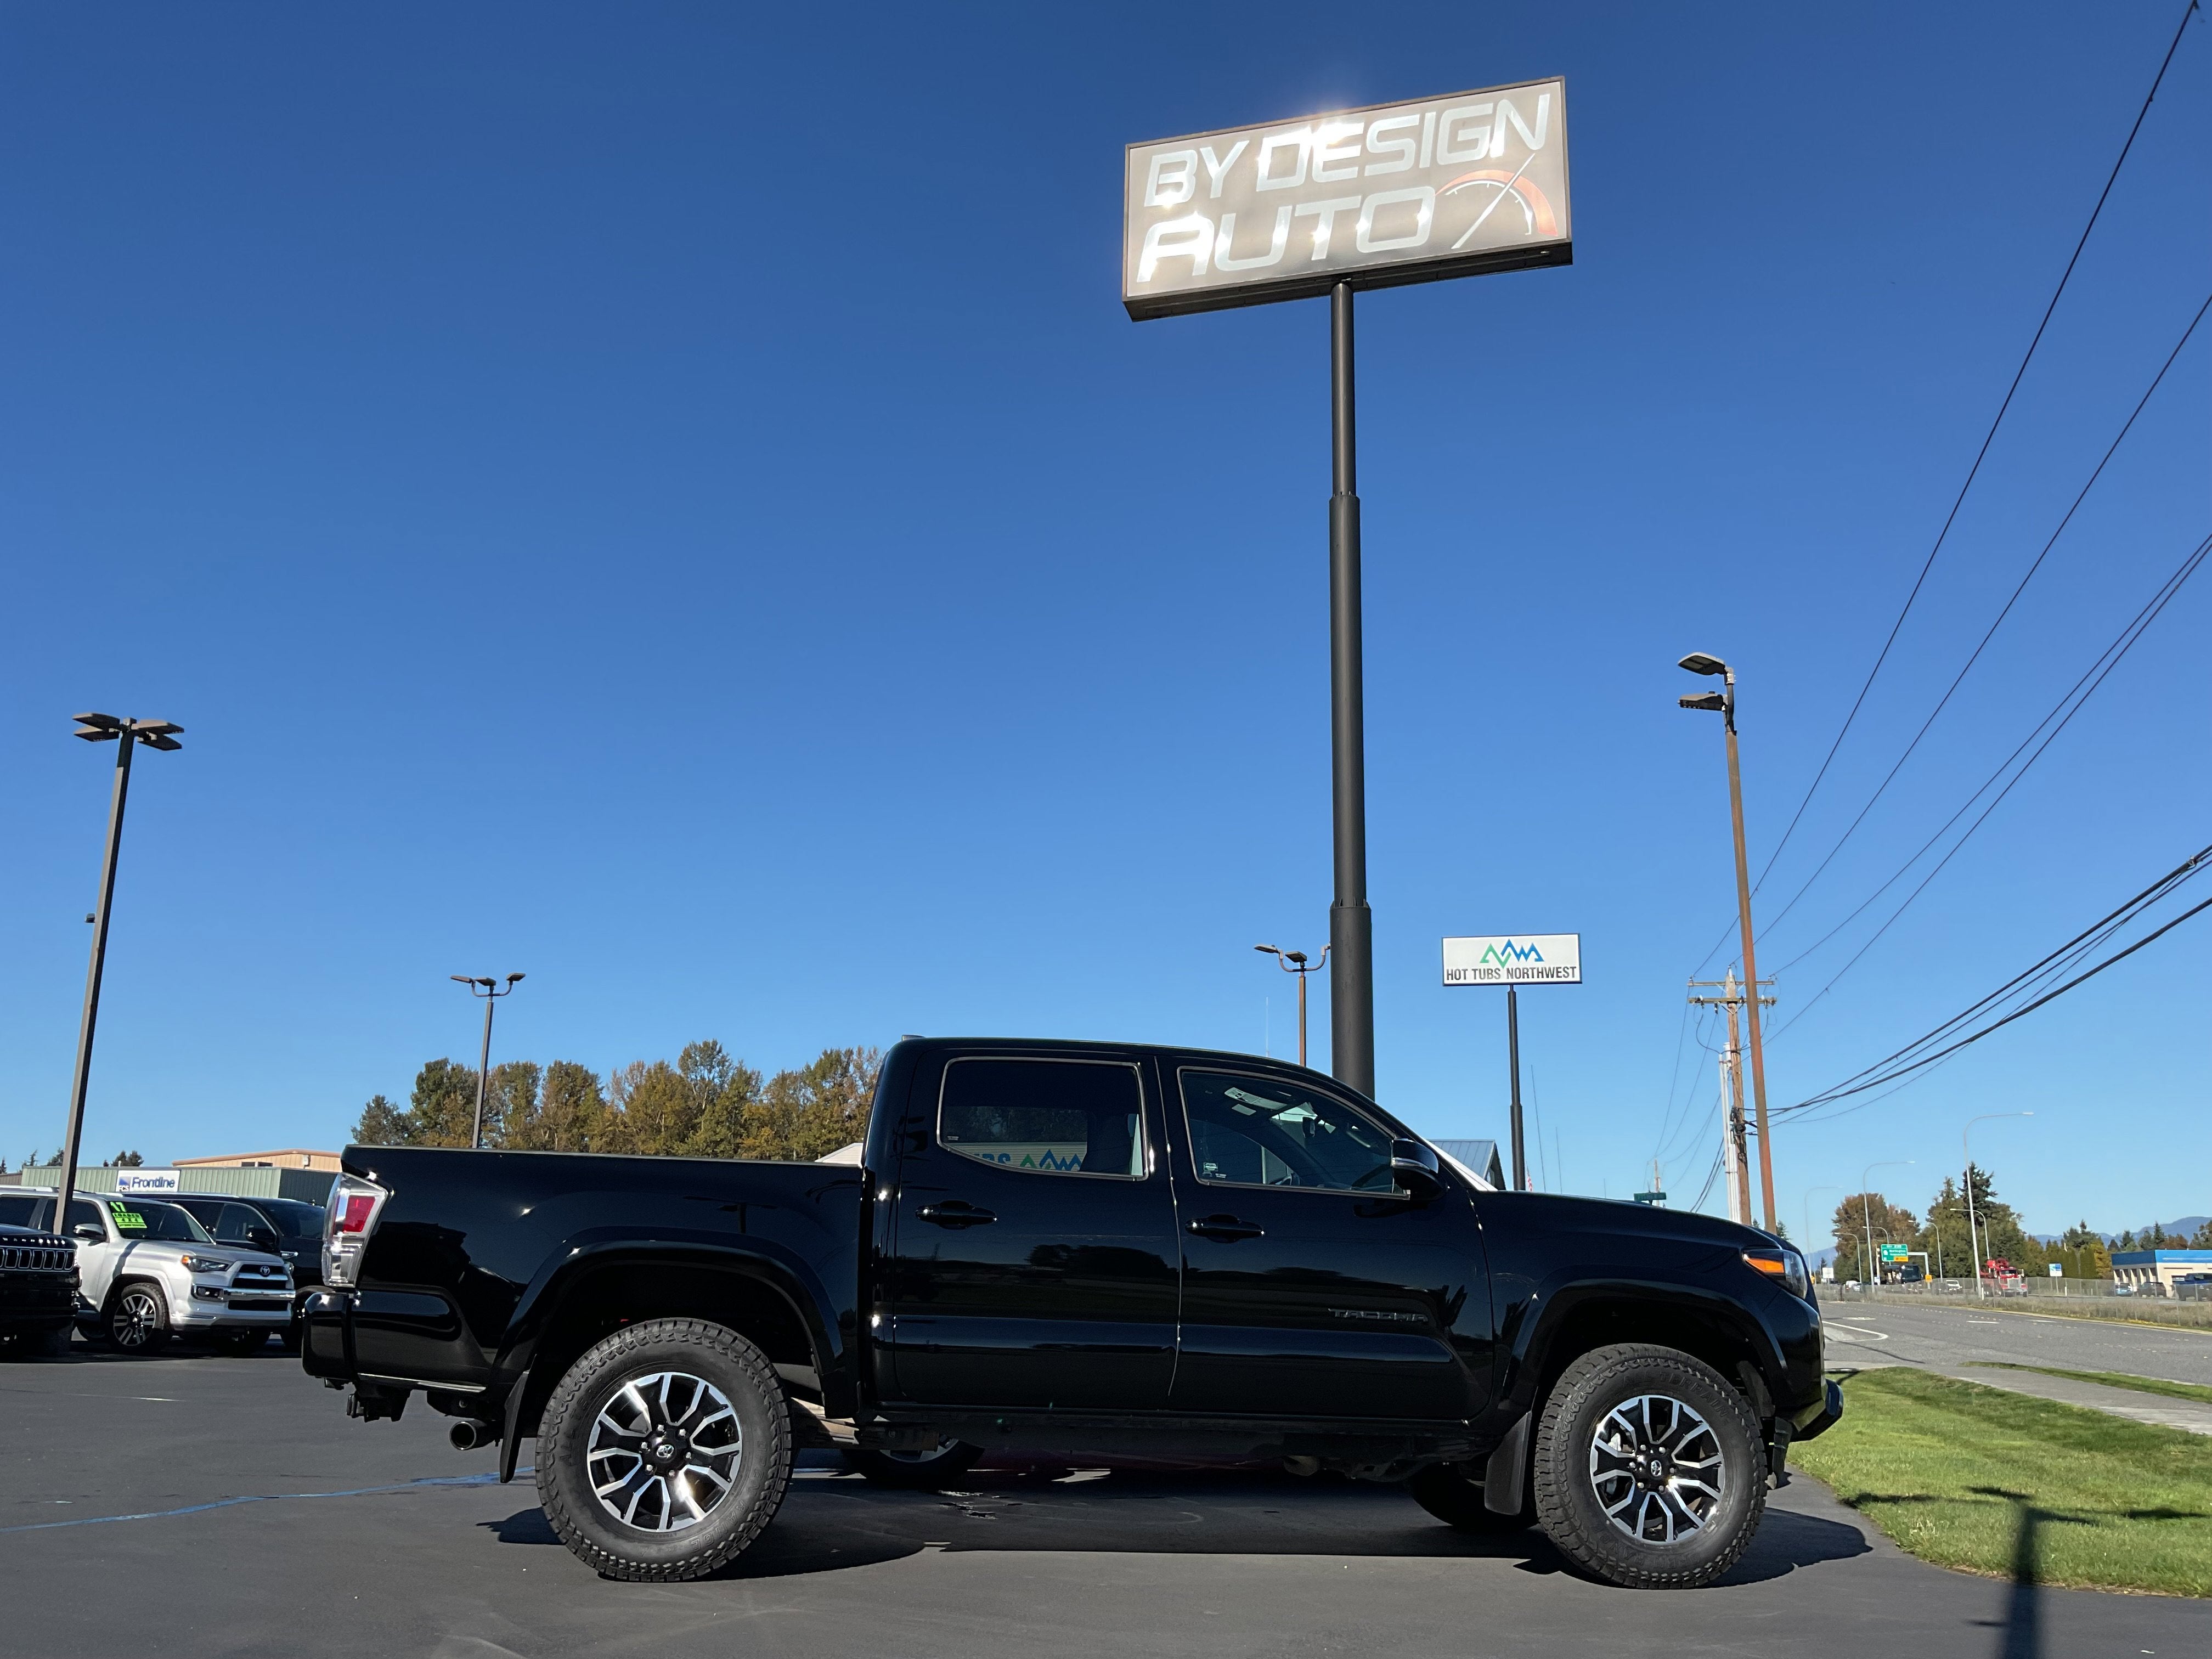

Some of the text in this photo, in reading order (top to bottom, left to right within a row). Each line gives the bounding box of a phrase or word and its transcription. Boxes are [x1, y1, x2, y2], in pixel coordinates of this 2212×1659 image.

[1143, 93, 1550, 207] BY DESIGN
[1137, 186, 1436, 283] AUTO
[1446, 966, 1576, 980] HOT TUBS NORTHWEST
[132, 1176, 176, 1188] Frontline
[110, 1201, 126, 1212] 17
[1328, 1308, 1428, 1322] TACOMA
